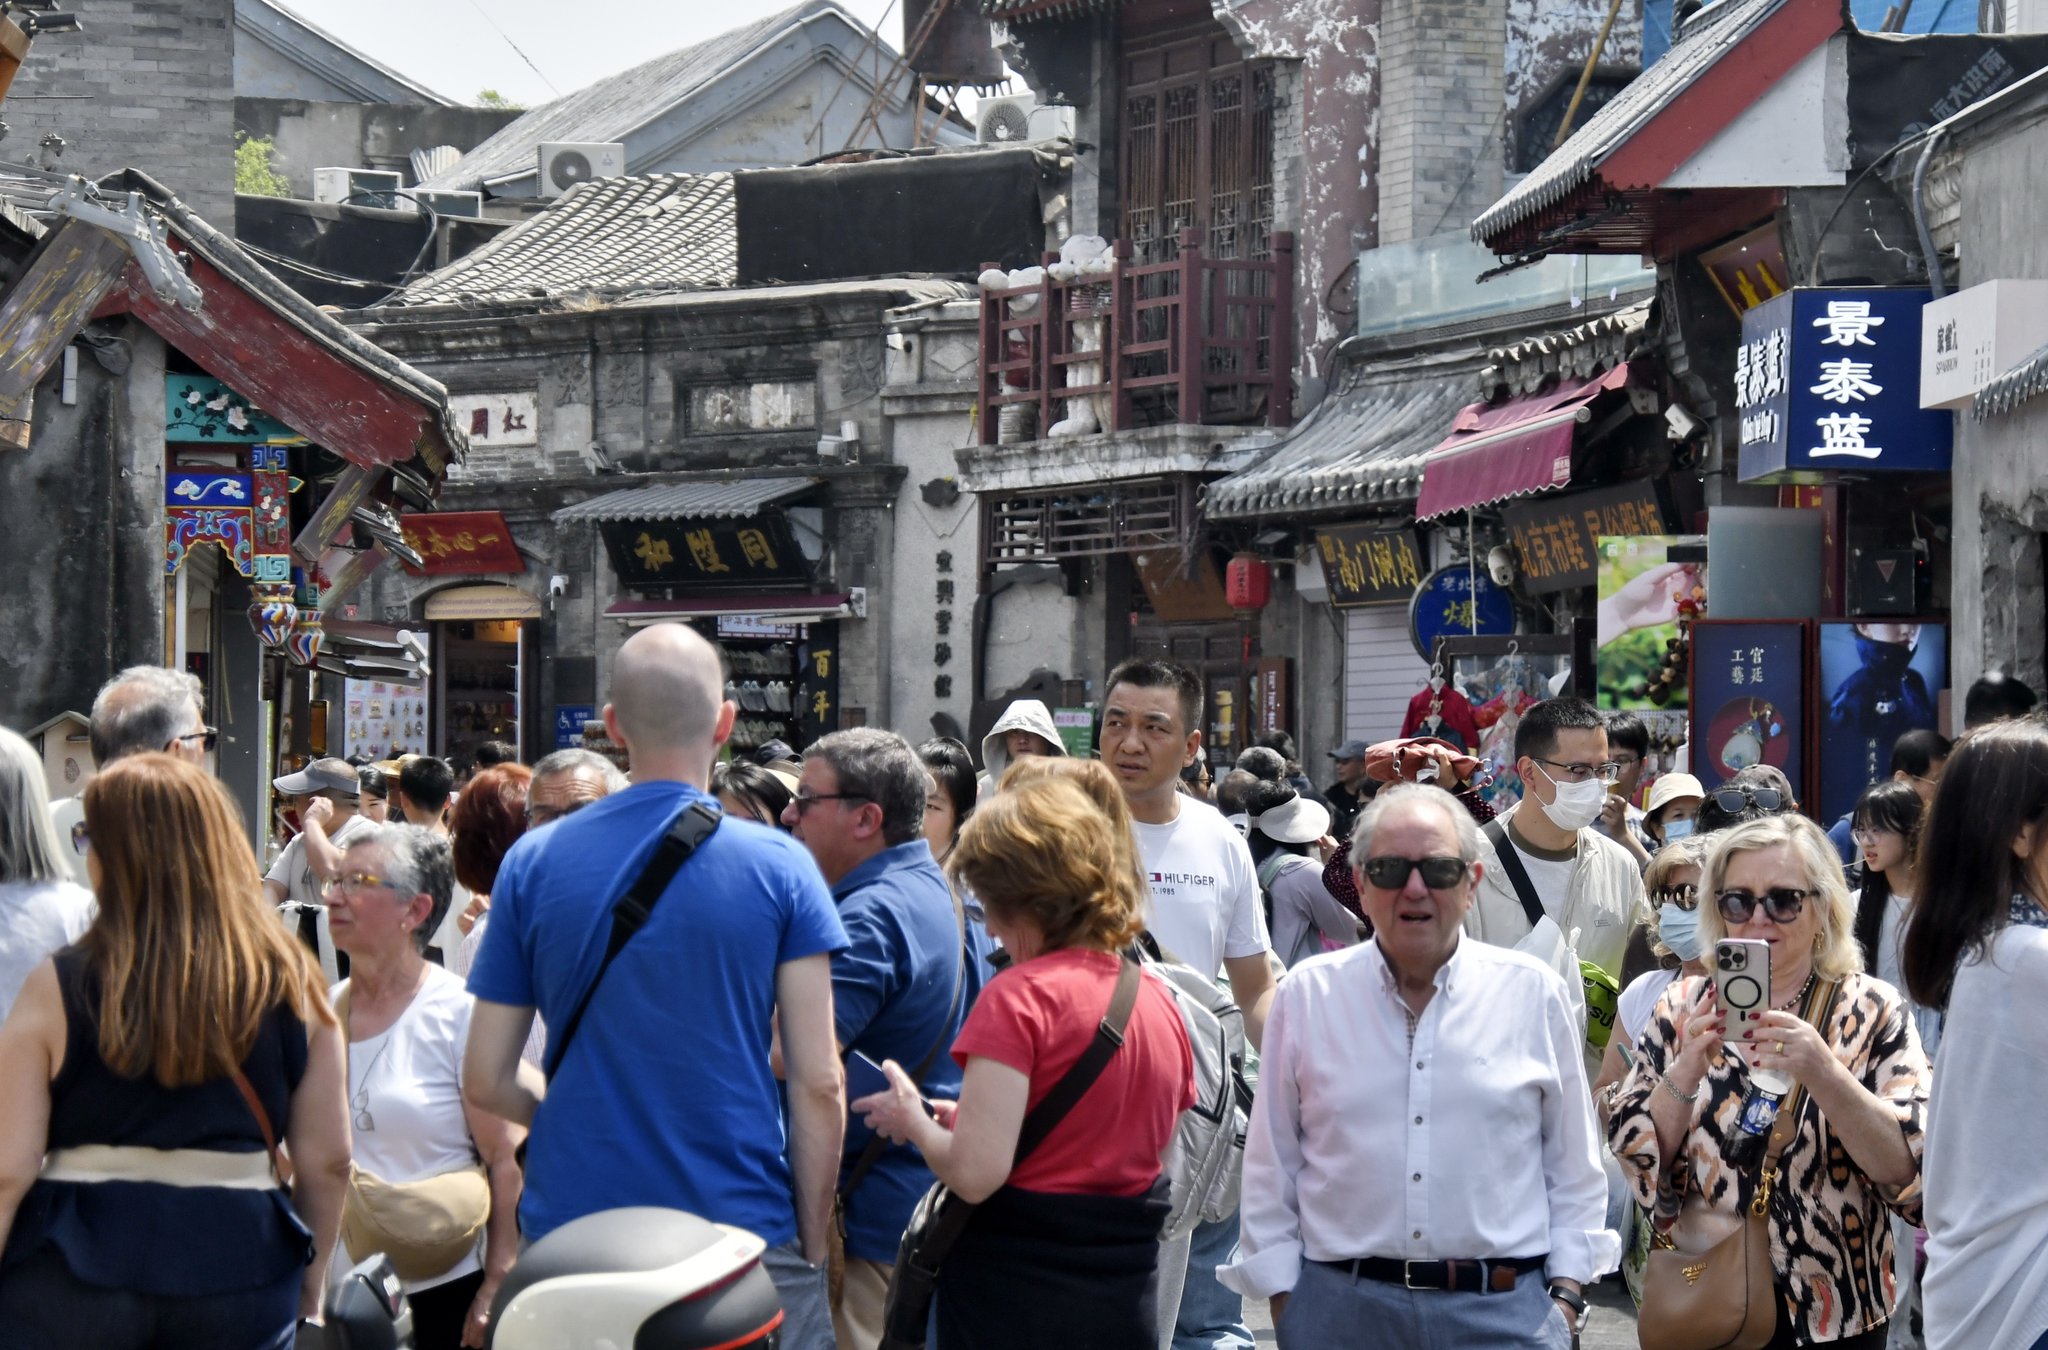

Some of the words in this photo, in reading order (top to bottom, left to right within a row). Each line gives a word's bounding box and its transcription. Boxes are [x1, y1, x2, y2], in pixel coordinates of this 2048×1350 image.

[1808, 301, 1886, 459] 景泰蓝
[1513, 513, 1590, 579] 北京布鞋
[1442, 576, 1488, 592] 老北京
[812, 649, 832, 723] 百年
[1164, 873, 1215, 886] HILFIGER
